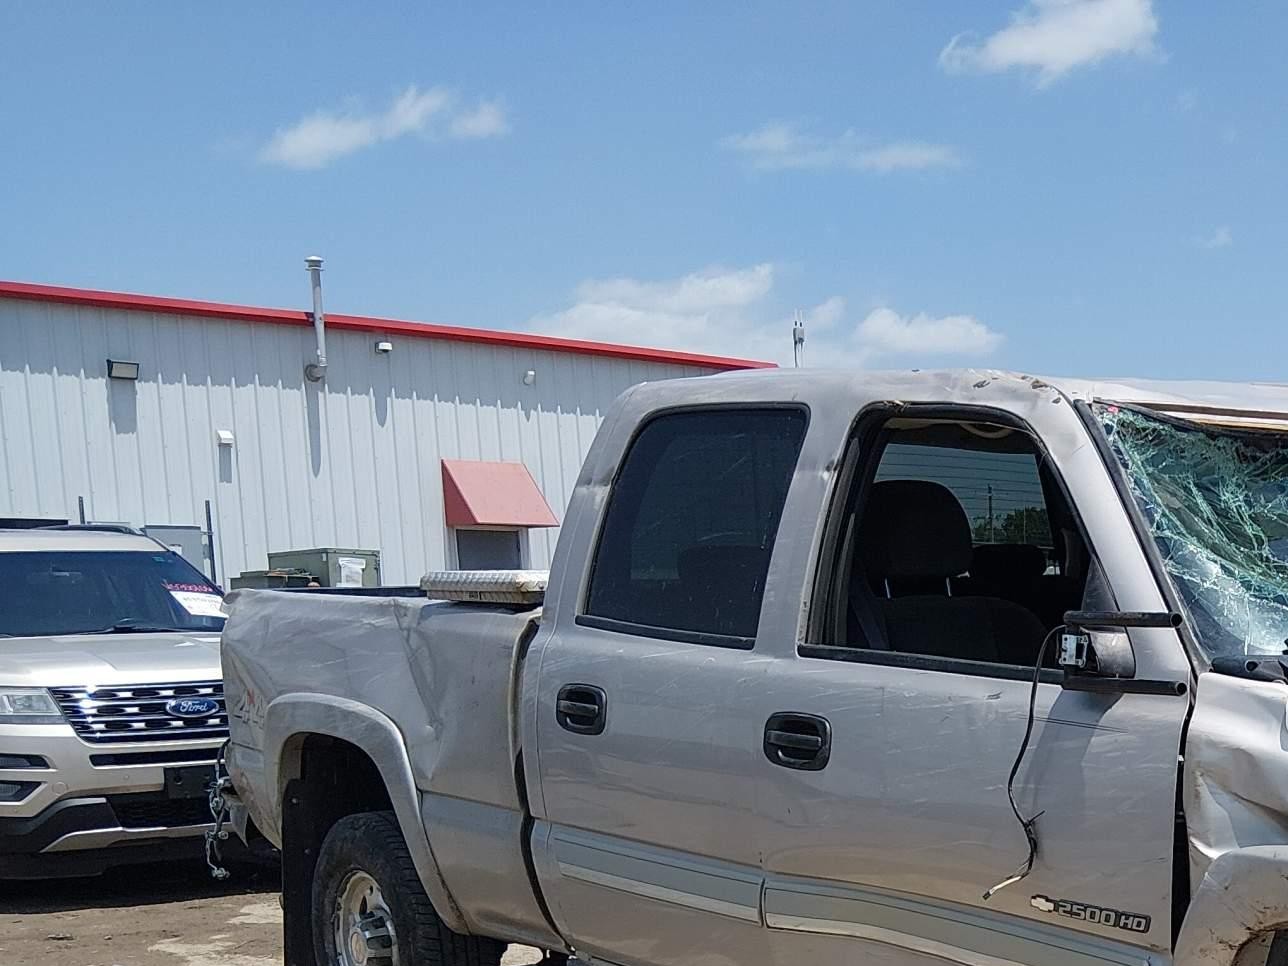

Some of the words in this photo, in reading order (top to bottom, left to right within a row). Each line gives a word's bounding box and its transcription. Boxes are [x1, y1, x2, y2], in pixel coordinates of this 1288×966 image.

[179, 700, 209, 713] Ford
[1058, 901, 1116, 926] 2500
[1119, 915, 1147, 931] HD
